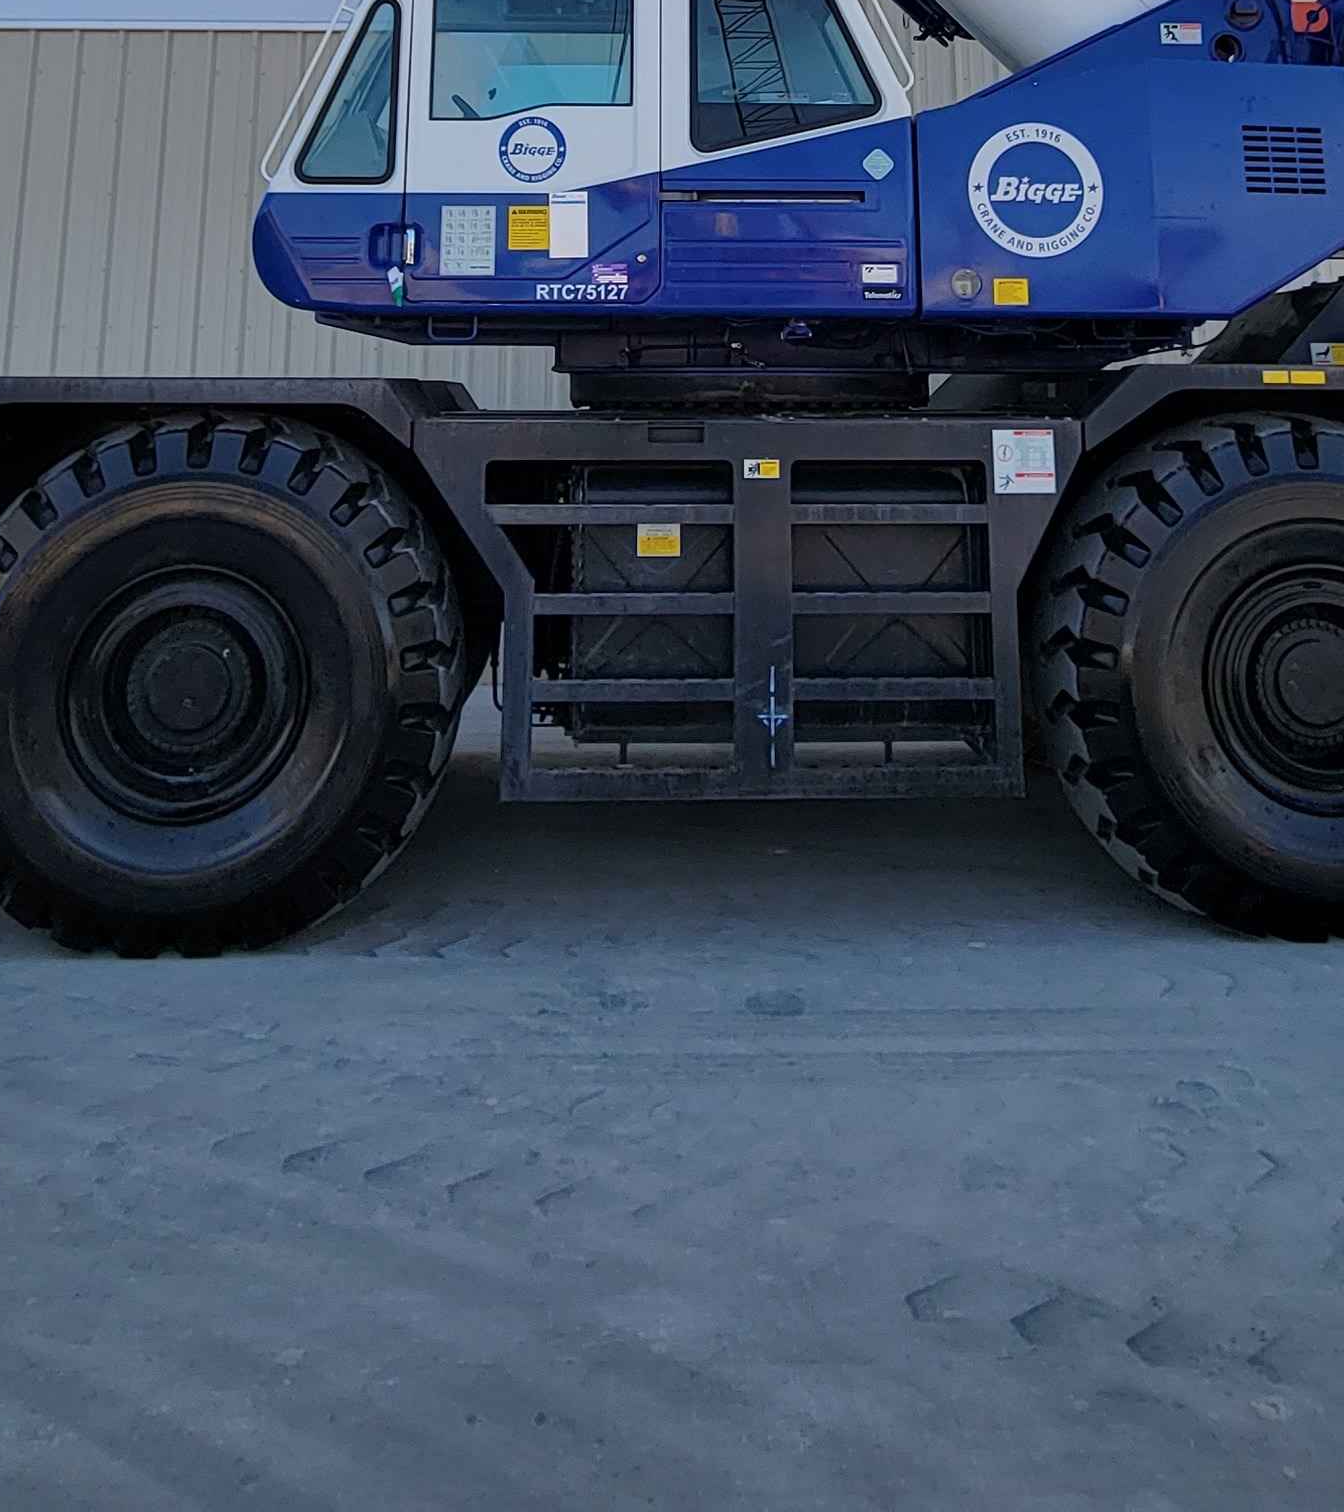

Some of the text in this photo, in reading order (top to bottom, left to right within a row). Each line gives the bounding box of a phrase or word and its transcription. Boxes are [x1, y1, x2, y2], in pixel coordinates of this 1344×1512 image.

[1005, 128, 1062, 144] EST. 1916
[976, 202, 1098, 254] CRANE AND RIGGING CO.
[535, 284, 629, 301] RTC75127
